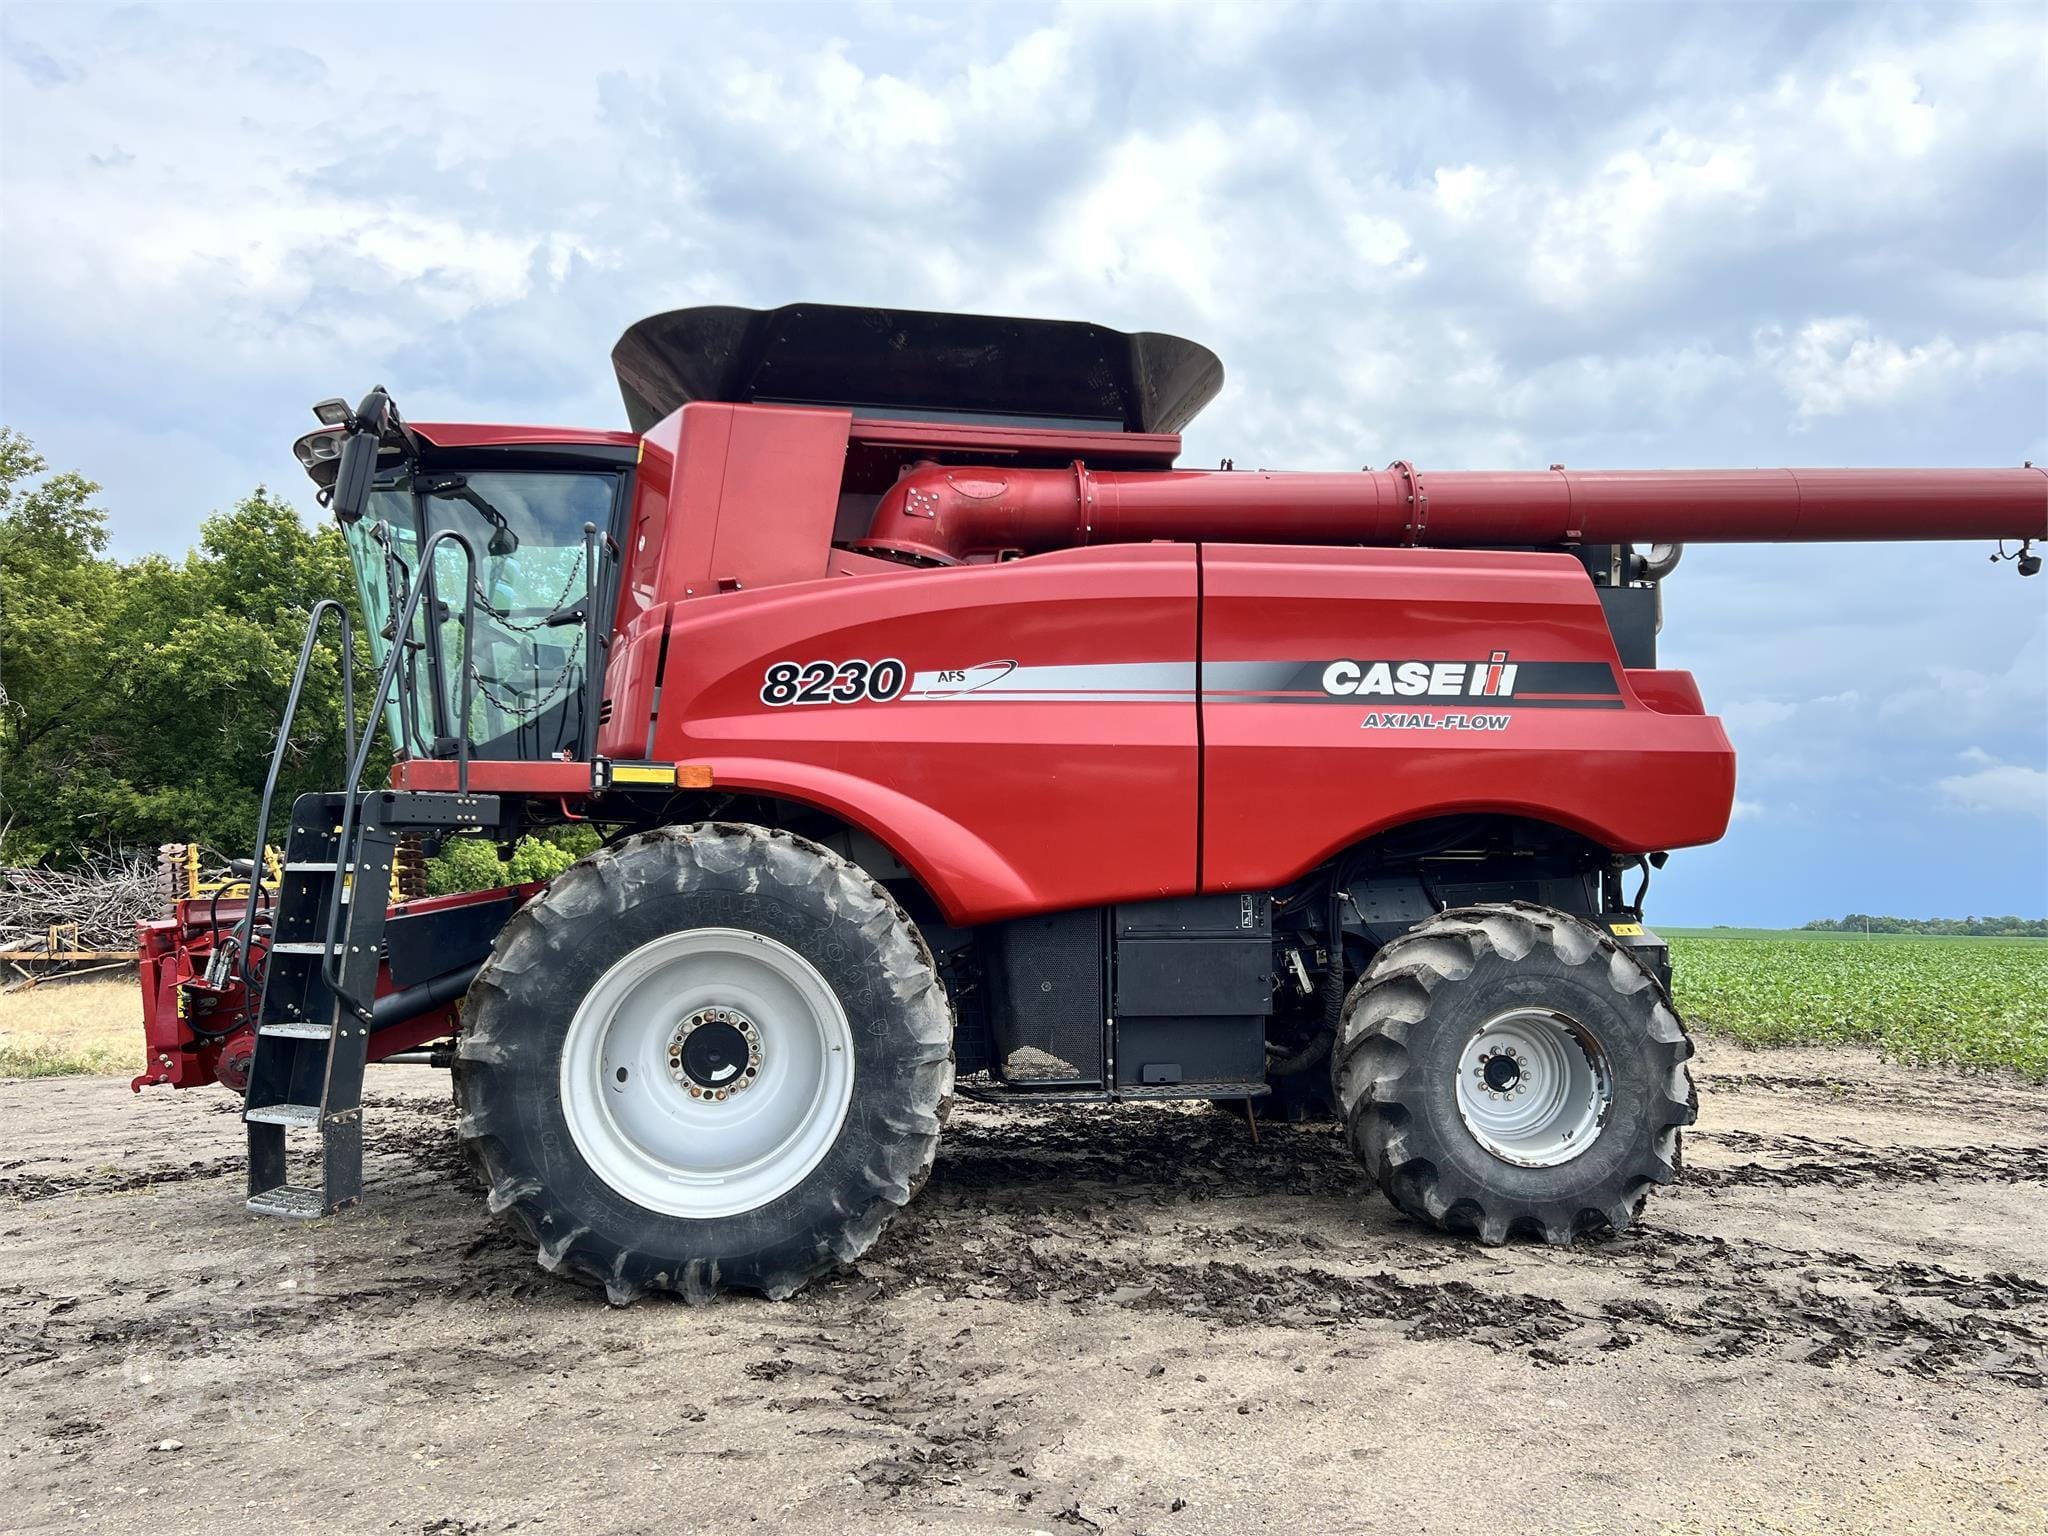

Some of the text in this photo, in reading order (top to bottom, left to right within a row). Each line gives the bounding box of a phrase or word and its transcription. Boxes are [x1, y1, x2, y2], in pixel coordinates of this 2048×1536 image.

[760, 657, 905, 706] 8230
[937, 670, 966, 683] AFS
[1322, 661, 1467, 697] CASE
[1361, 713, 1511, 730] AXIAL-FLOW
